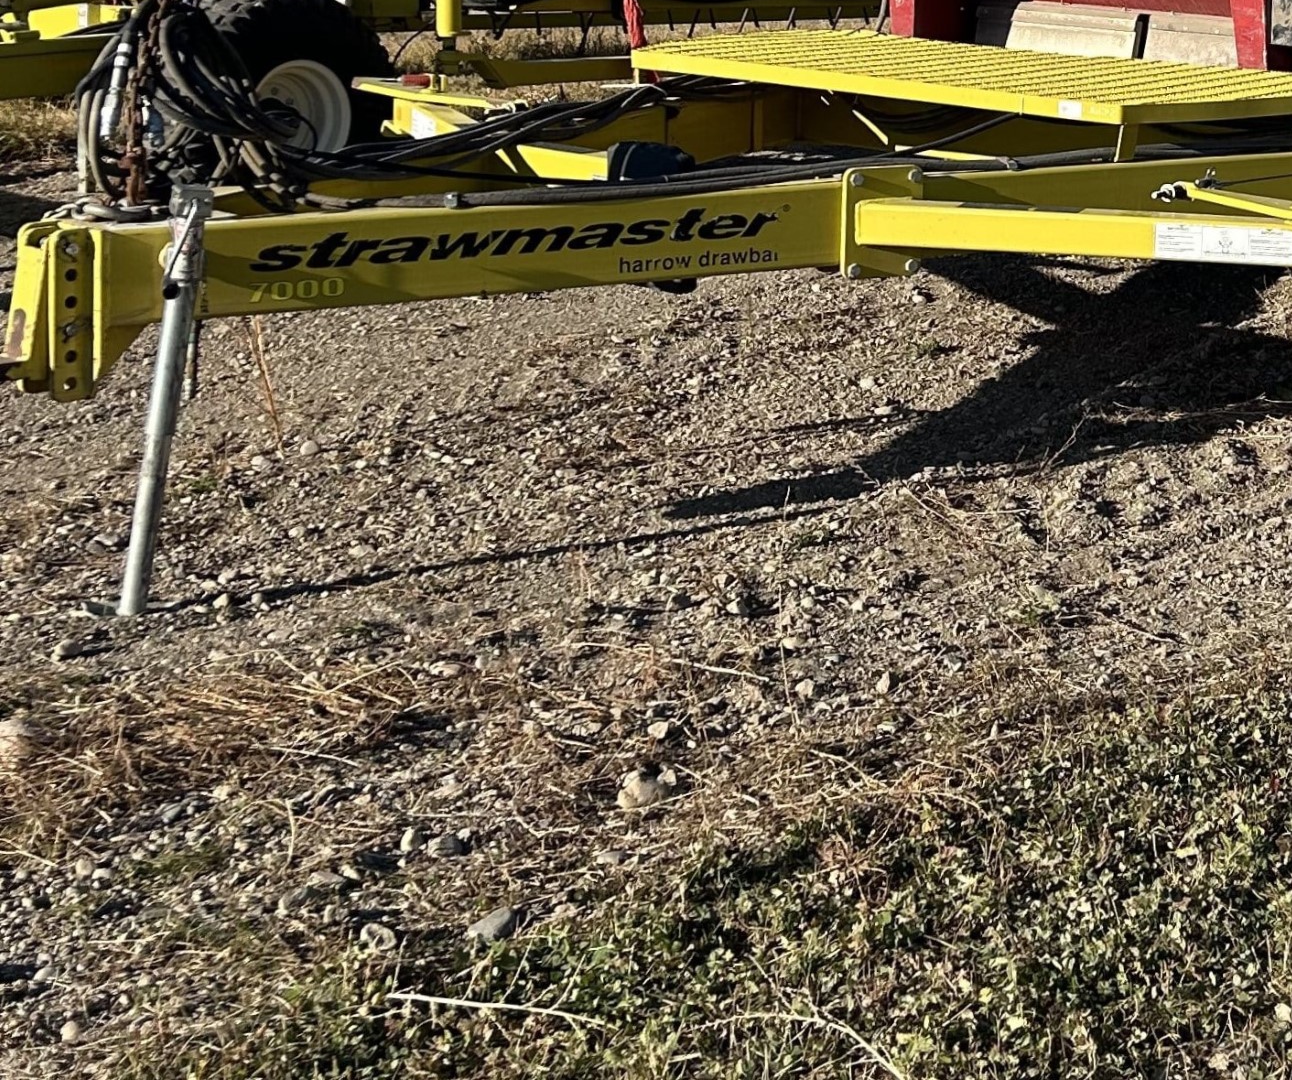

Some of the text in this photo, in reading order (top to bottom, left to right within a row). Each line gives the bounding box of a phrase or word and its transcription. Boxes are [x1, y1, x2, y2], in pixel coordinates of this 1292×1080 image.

[250, 207, 780, 272] strawmaster
[619, 254, 692, 274] harrow
[250, 277, 345, 303] 7000
